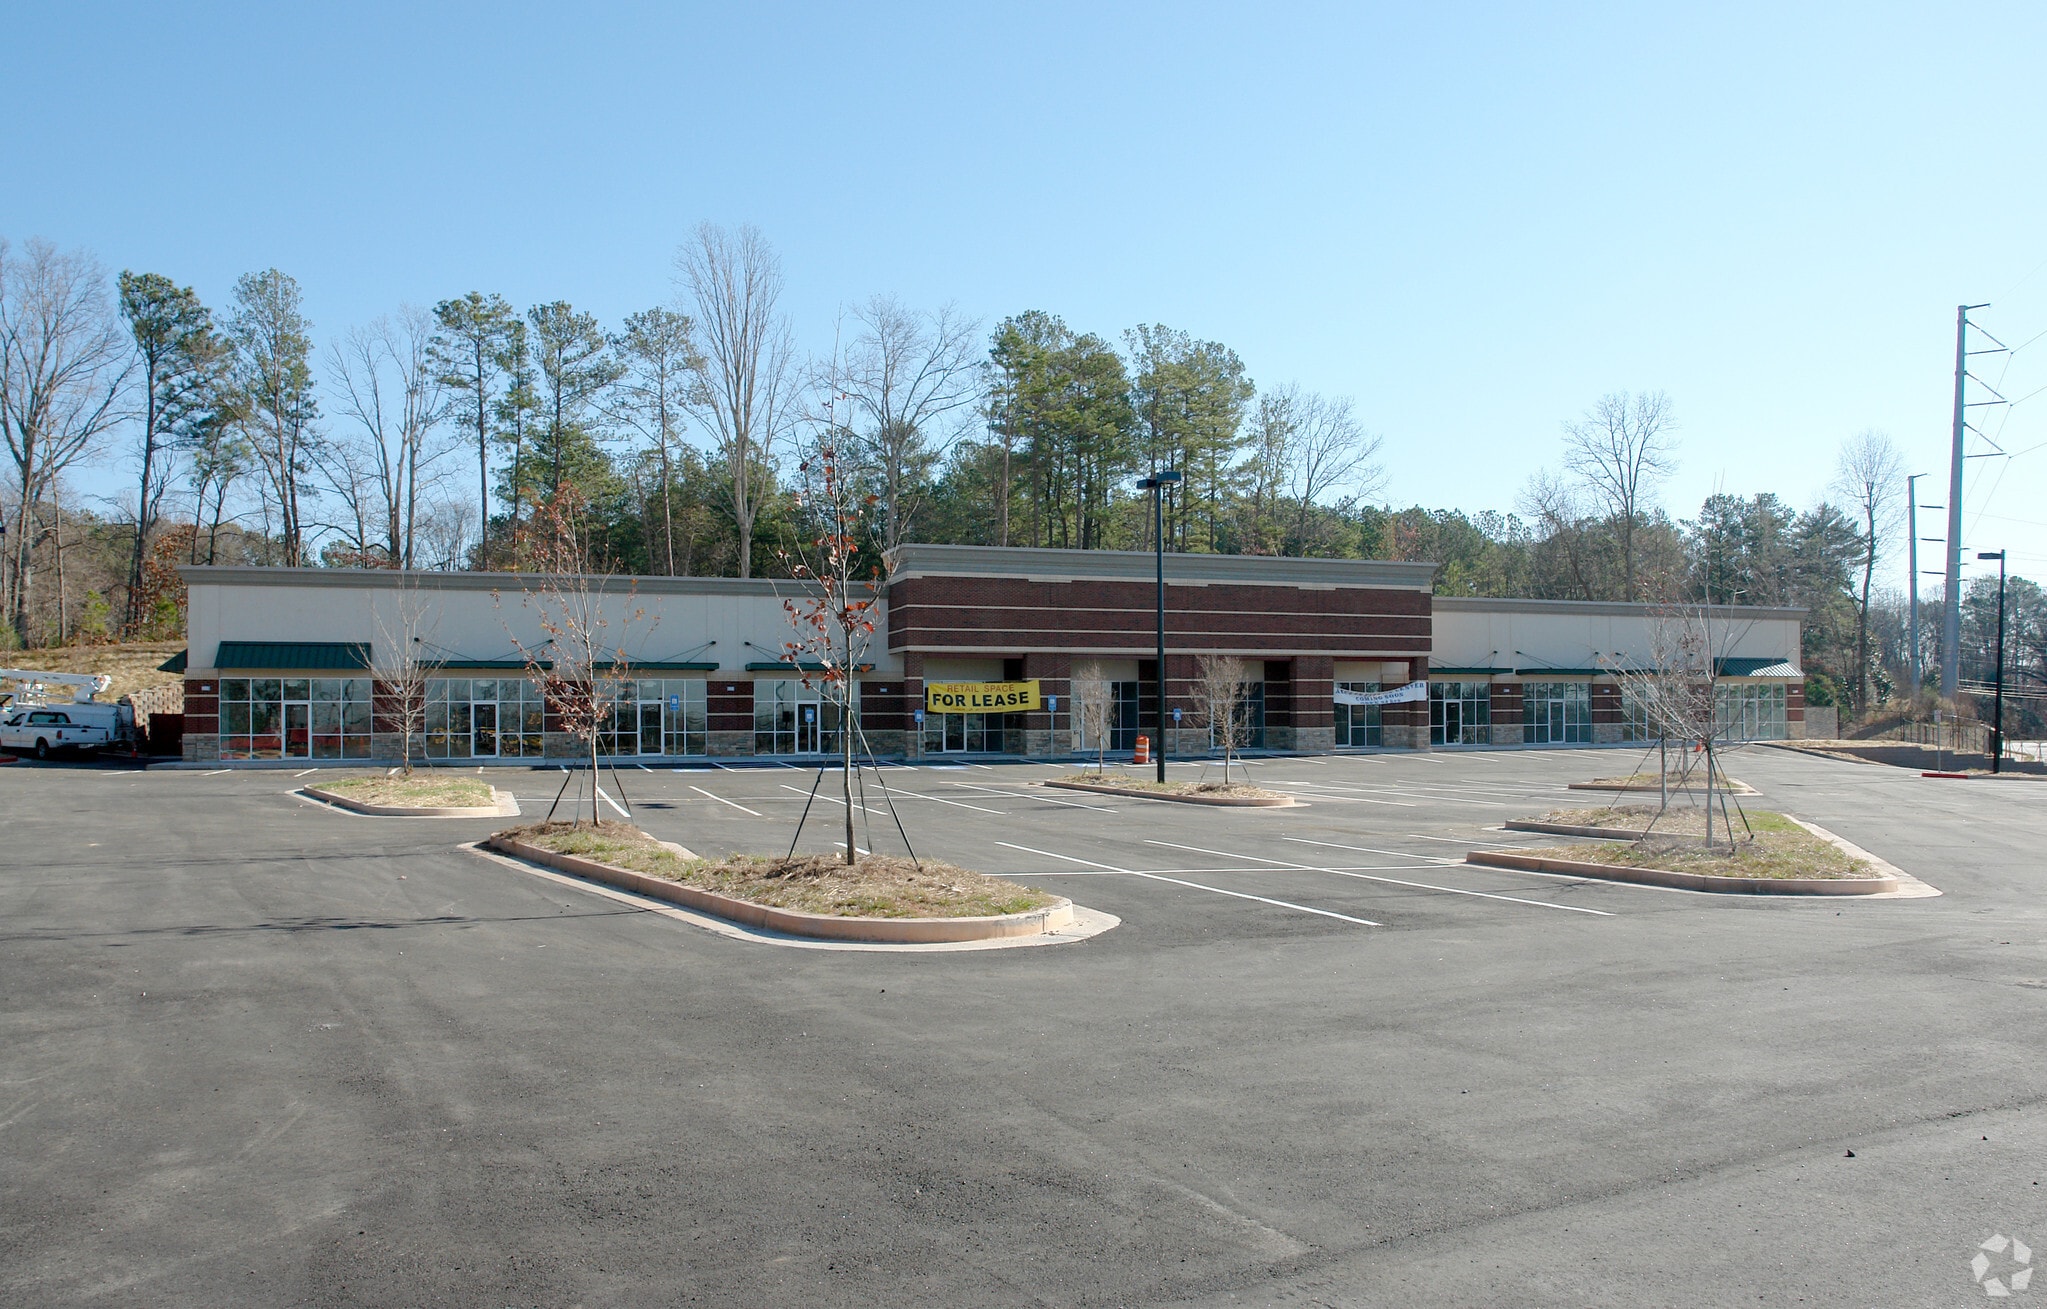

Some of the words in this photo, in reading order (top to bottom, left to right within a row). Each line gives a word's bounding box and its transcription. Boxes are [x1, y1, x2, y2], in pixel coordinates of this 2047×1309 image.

[946, 684, 979, 693] RETAIL
[984, 683, 1015, 692] SPACE
[932, 694, 966, 706] FOR
[972, 691, 1029, 706] LEASE
[1384, 692, 1404, 700] SOON
